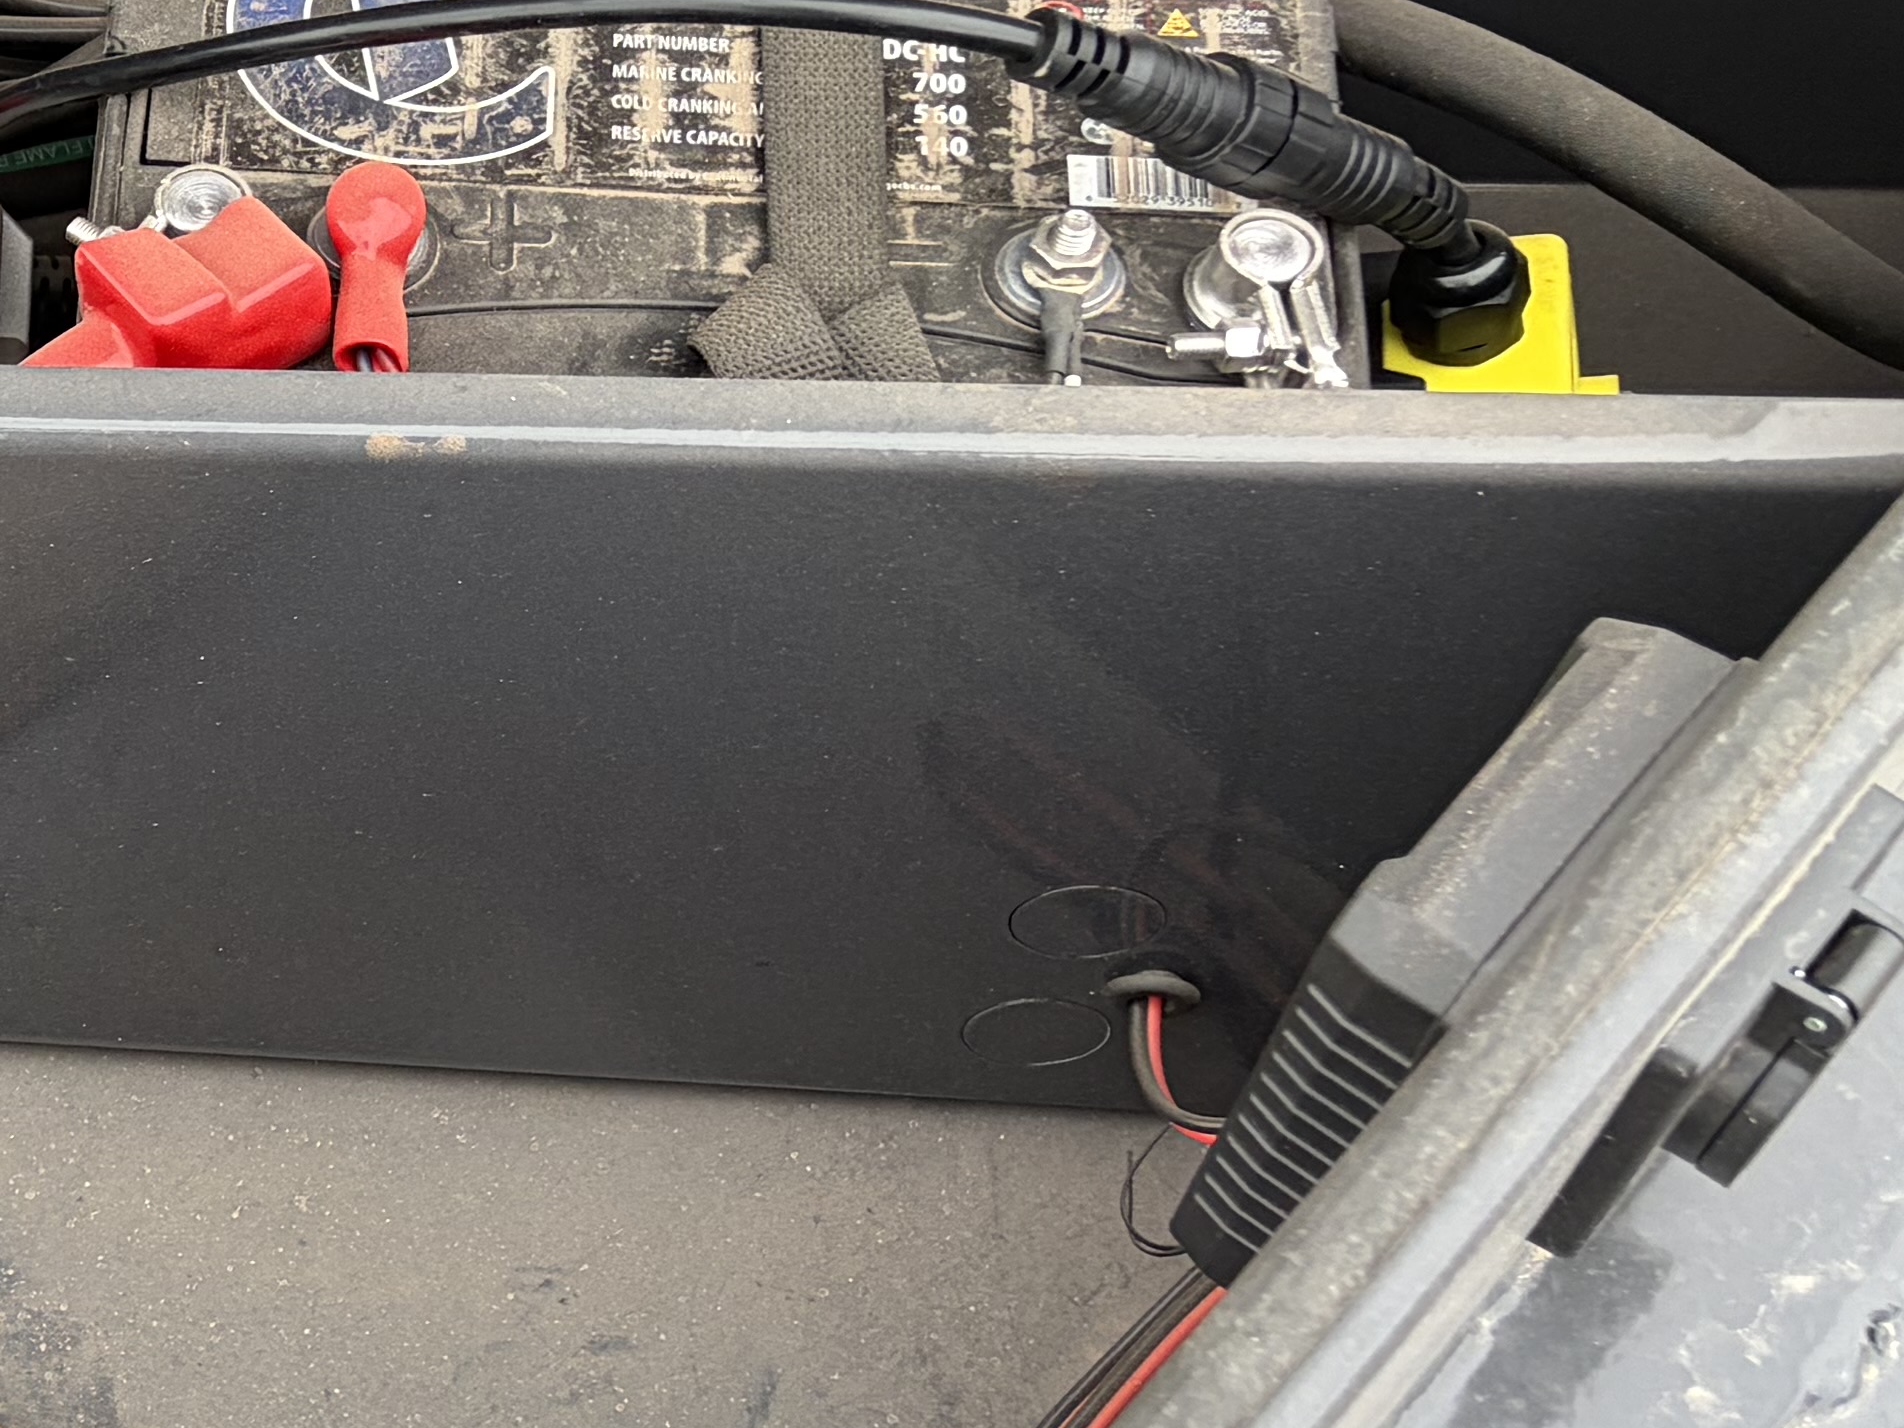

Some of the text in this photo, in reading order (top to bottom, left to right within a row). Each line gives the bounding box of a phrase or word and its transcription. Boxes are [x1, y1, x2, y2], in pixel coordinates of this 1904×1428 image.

[613, 33, 653, 49] PART
[659, 35, 730, 52] NUMBER
[913, 72, 966, 94] 700
[611, 94, 652, 111] COLD
[913, 104, 967, 125] 560
[686, 130, 765, 148] CAPACITY
[915, 135, 968, 158] 140
